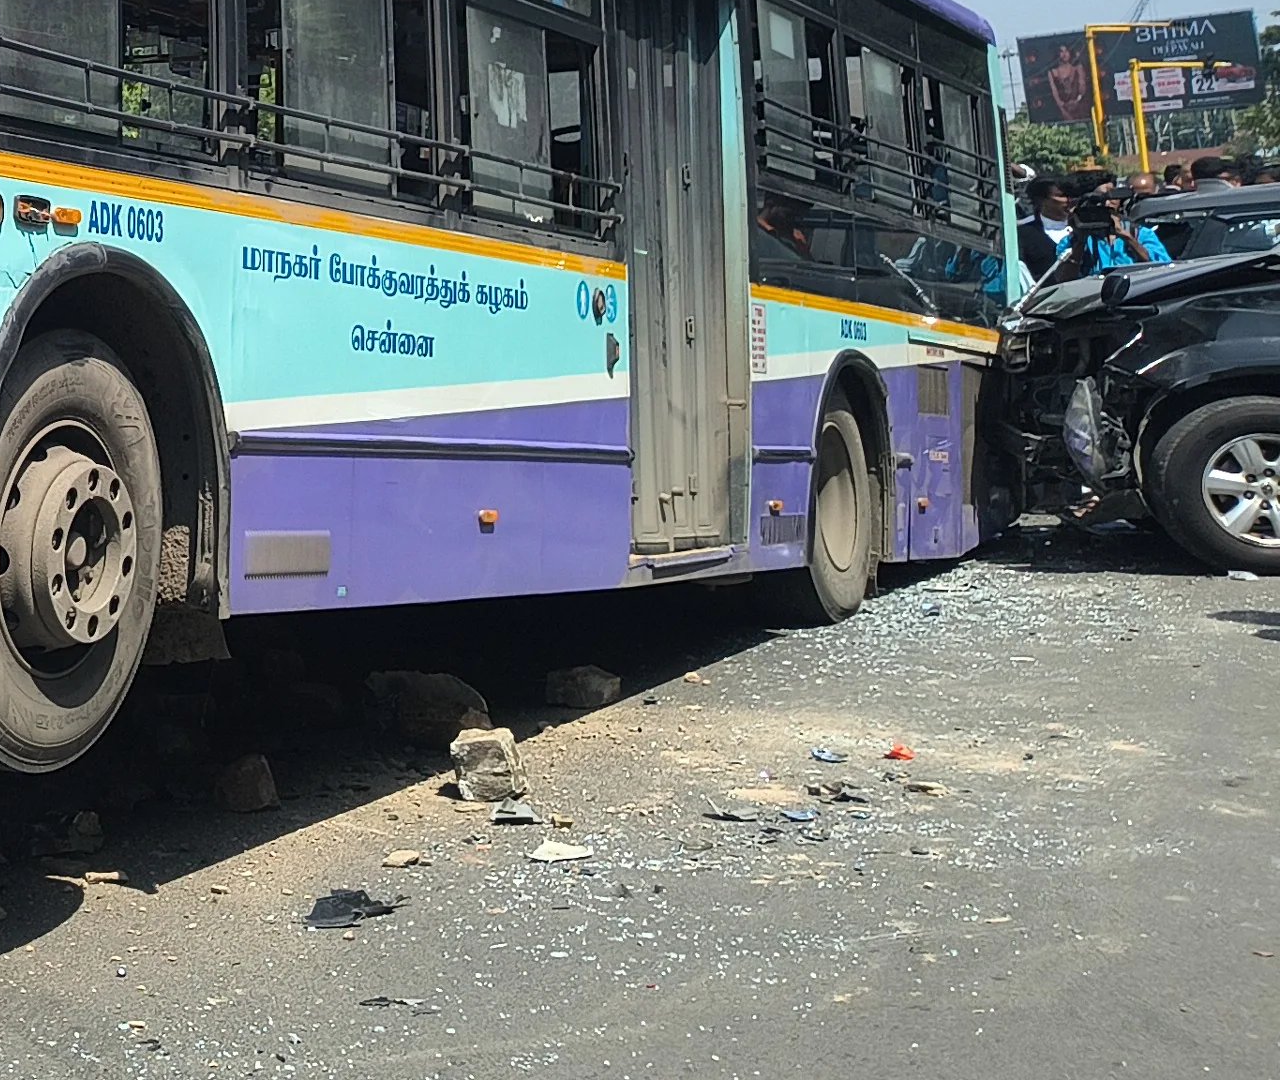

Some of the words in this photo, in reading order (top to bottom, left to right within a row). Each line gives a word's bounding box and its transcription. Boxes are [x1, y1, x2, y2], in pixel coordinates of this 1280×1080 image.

[1136, 19, 1217, 42] BHIMA
[89, 201, 124, 238] ADK
[126, 208, 164, 243] 0603
[241, 245, 320, 283] மாநகர்
[329, 255, 471, 306] போக்குவரத்துக்
[476, 278, 529, 312] கழகம்
[351, 323, 434, 359] சென்னை
